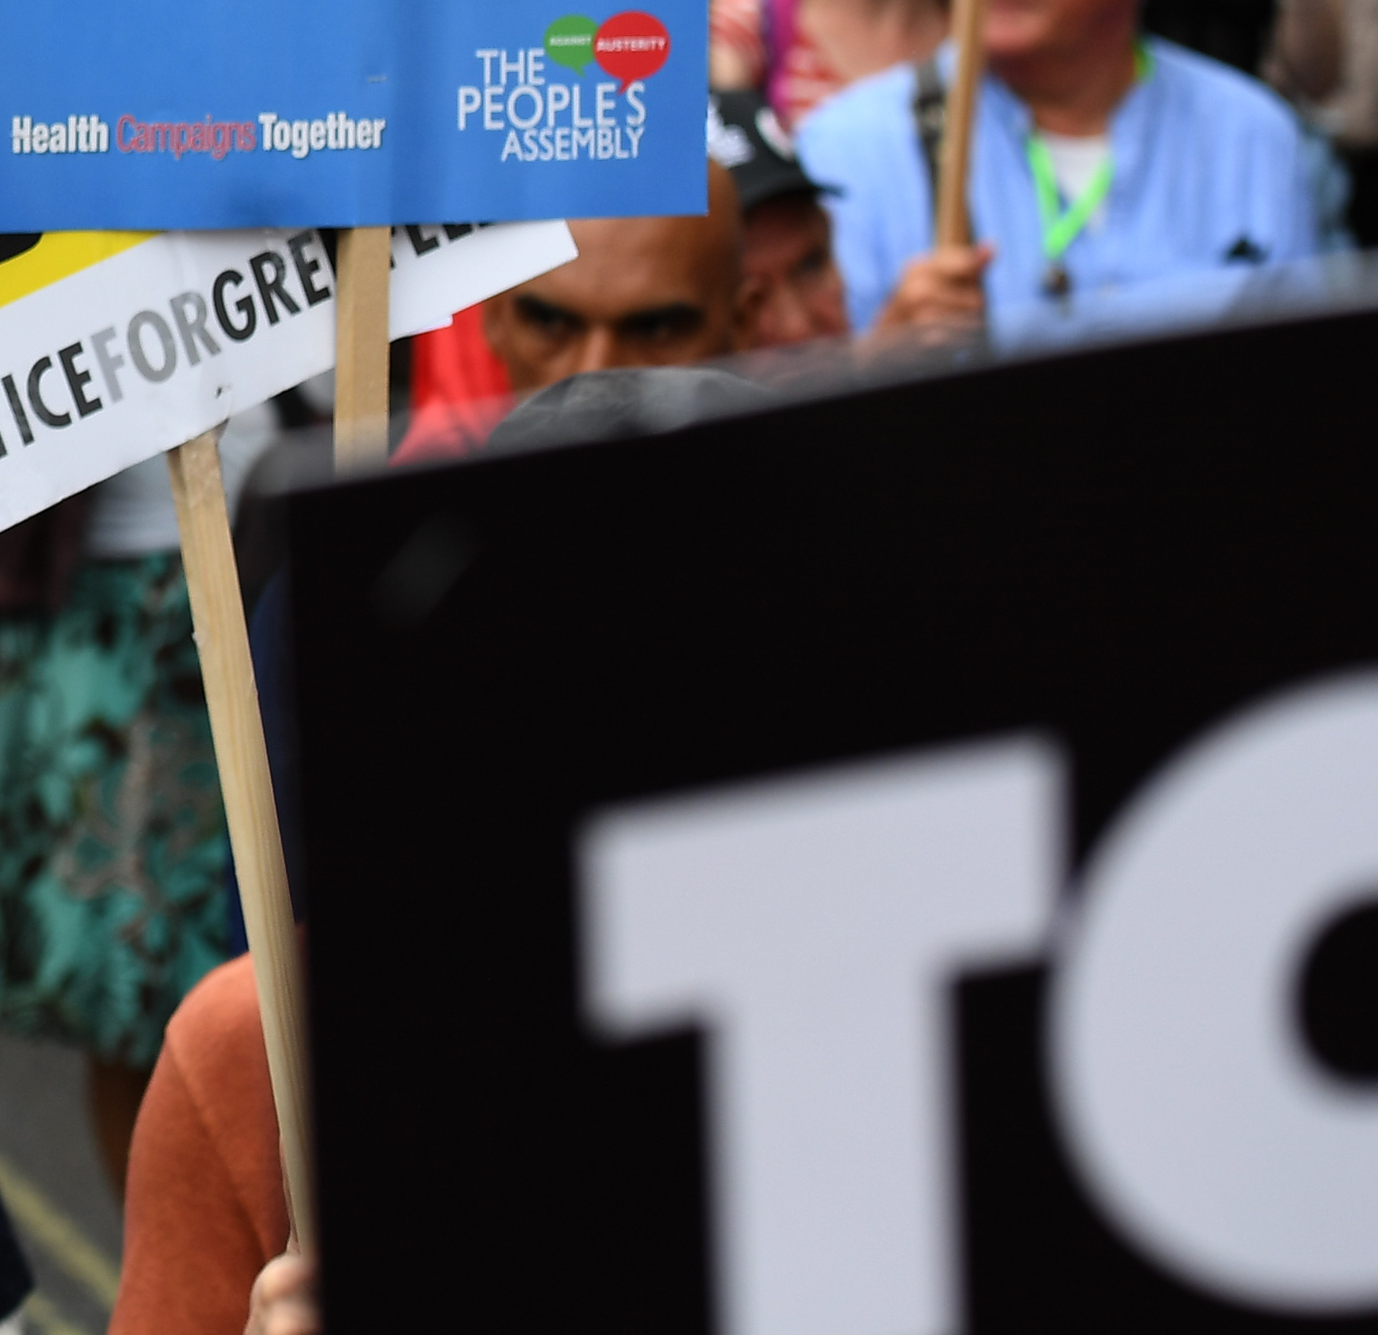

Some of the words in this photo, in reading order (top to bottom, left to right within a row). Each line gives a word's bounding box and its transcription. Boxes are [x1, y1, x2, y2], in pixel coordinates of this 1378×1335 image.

[596, 36, 666, 53] AUSTERITY
[475, 48, 545, 86] THE
[11, 114, 110, 155] Health
[116, 112, 257, 162] Campaigns
[258, 110, 387, 160] Together
[500, 126, 645, 163] ASSEMBLY
